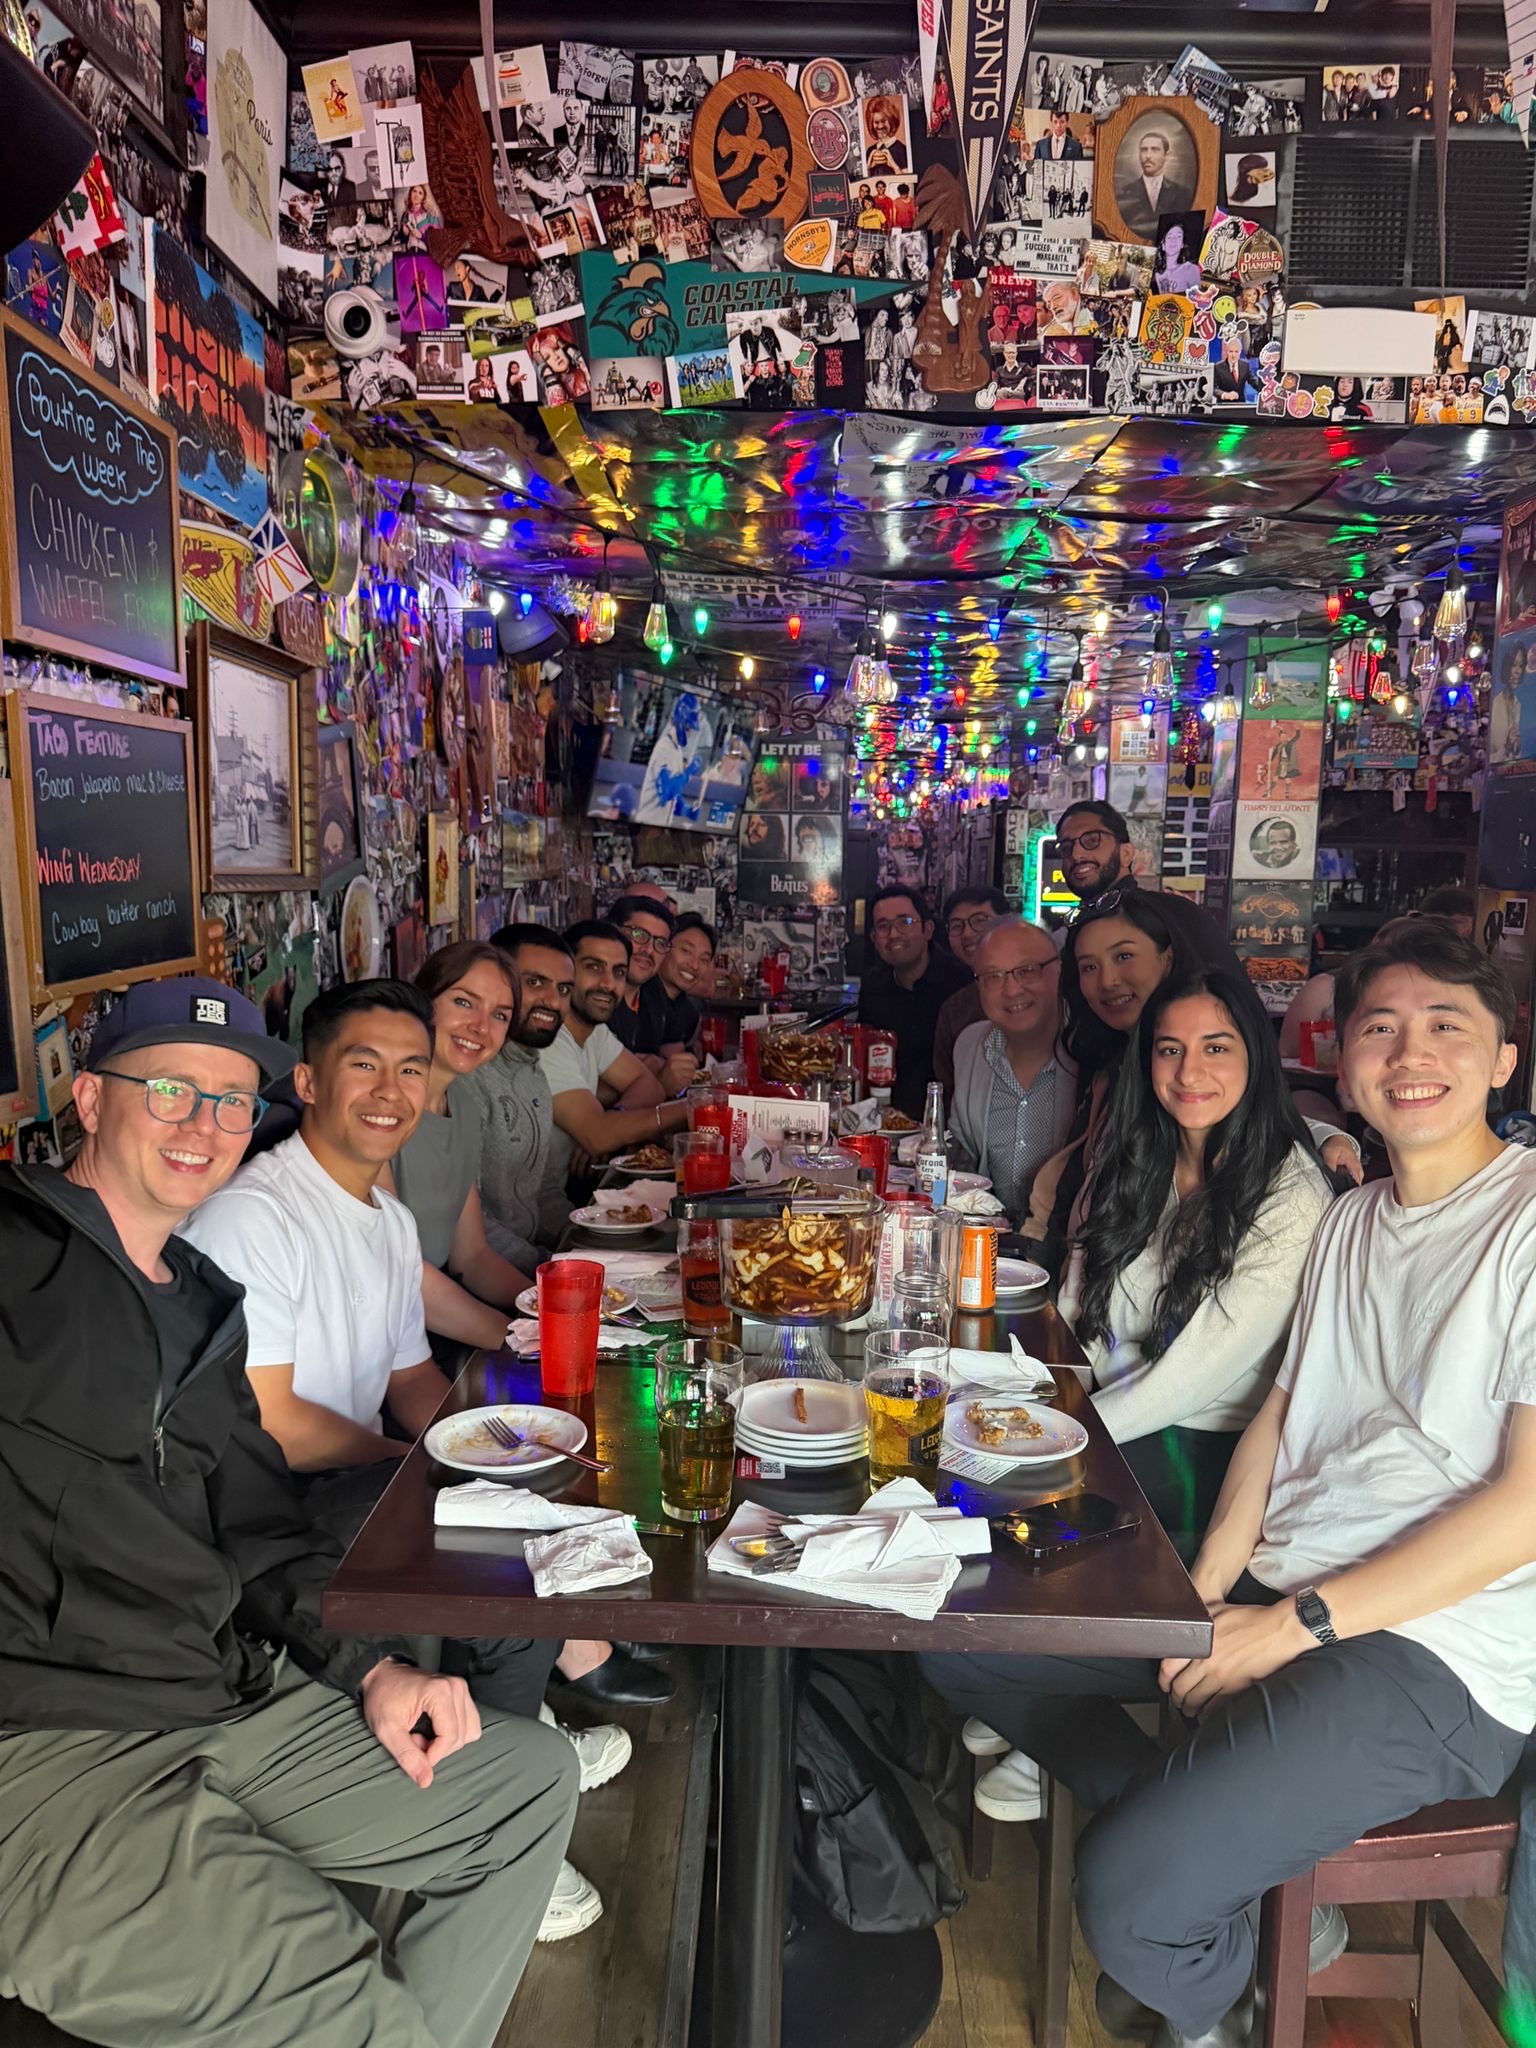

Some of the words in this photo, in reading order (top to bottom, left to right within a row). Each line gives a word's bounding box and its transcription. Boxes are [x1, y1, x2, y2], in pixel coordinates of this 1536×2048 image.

[970, 0, 1005, 121] SAINTS
[246, 99, 273, 146] Paris
[786, 225, 826, 252] HORNSBY'S
[1058, 246, 1073, 254] HAVE
[1240, 261, 1282, 274] DIAMOND
[1244, 250, 1278, 263] DOUBLE
[684, 276, 801, 307] COASTAL
[990, 274, 1033, 287] BREWS
[28, 373, 96, 443] Poutine
[106, 420, 123, 455] of
[129, 431, 157, 475] The
[30, 483, 138, 585] CHICKEN
[761, 743, 786, 756] LET
[787, 743, 803, 756] IT
[804, 743, 822, 756] BE
[36, 767, 75, 801] Bacon
[1243, 804, 1267, 812] HARRY
[1269, 804, 1311, 813] BELAFONTE
[106, 898, 140, 926] butter
[145, 892, 177, 919] ranch
[917, 1156, 945, 1168] Corona
